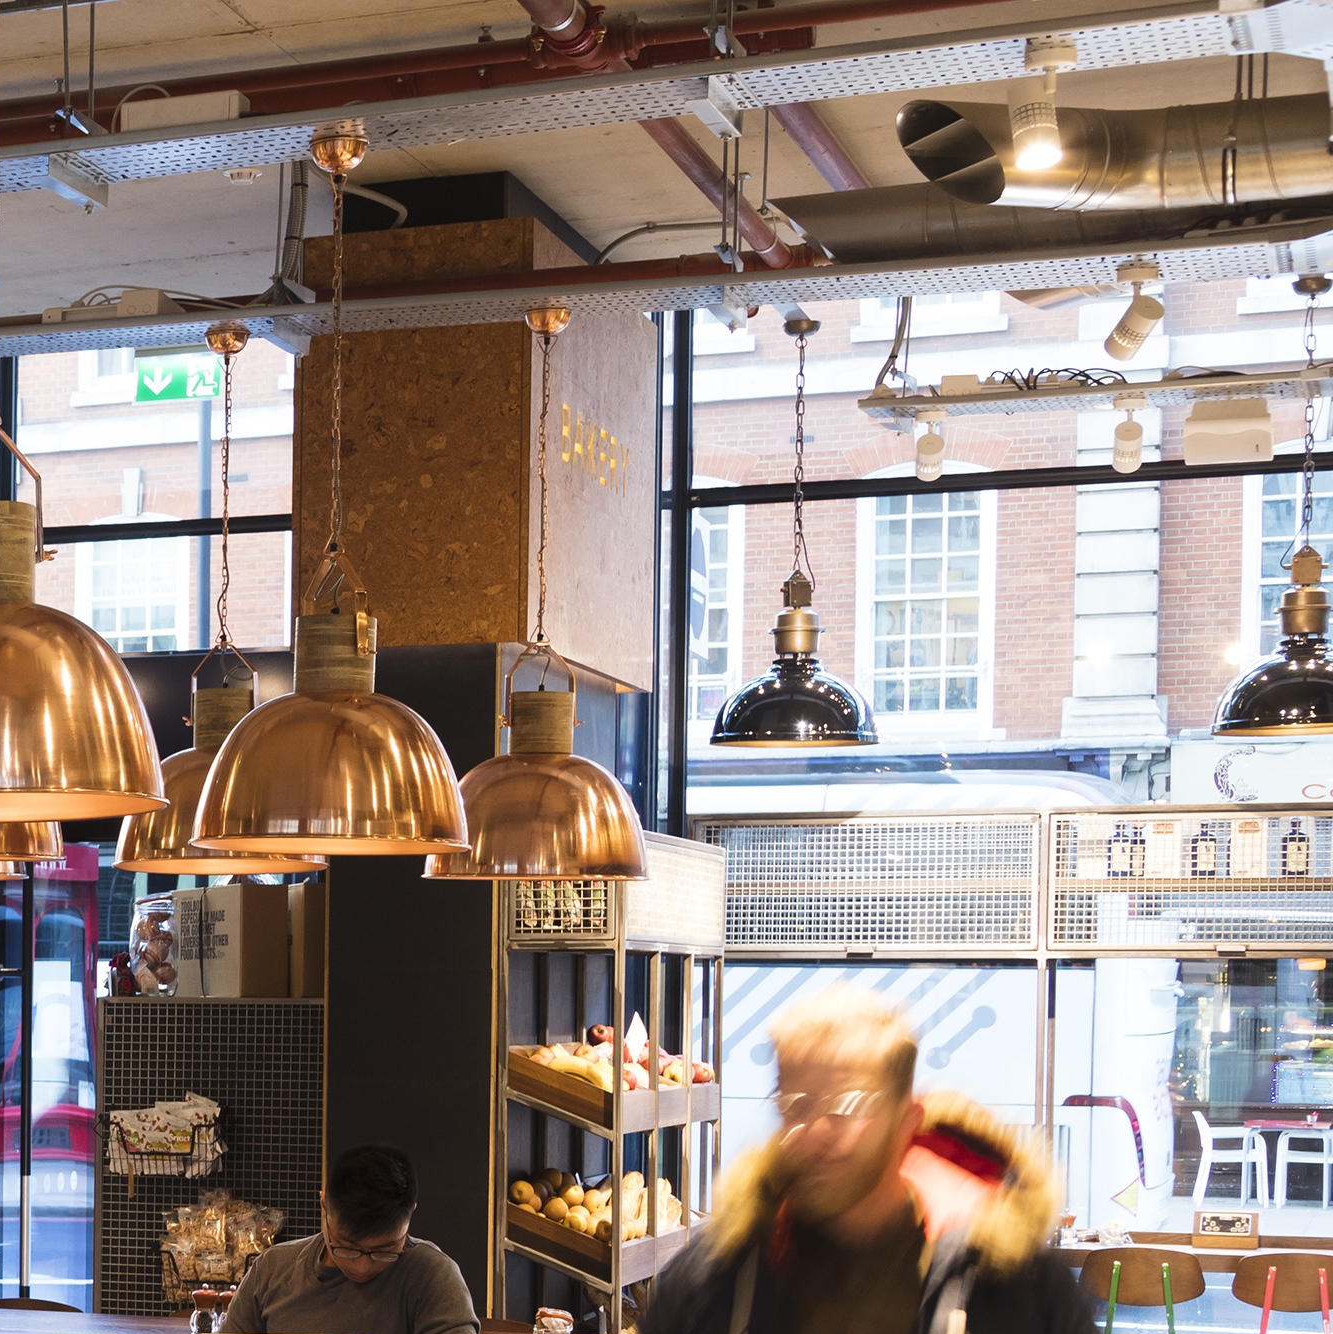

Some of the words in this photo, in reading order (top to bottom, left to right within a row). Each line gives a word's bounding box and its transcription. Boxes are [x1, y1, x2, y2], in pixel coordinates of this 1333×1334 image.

[562, 402, 629, 498] BAKERY
[181, 901, 202, 912] TOOLBO
[210, 910, 225, 922] MADE
[181, 926, 190, 936] FOR
[192, 923, 215, 936] GOUMET
[212, 934, 228, 946] OTHER
[181, 949, 193, 960] FOOD
[194, 947, 217, 960] ADICTS.
